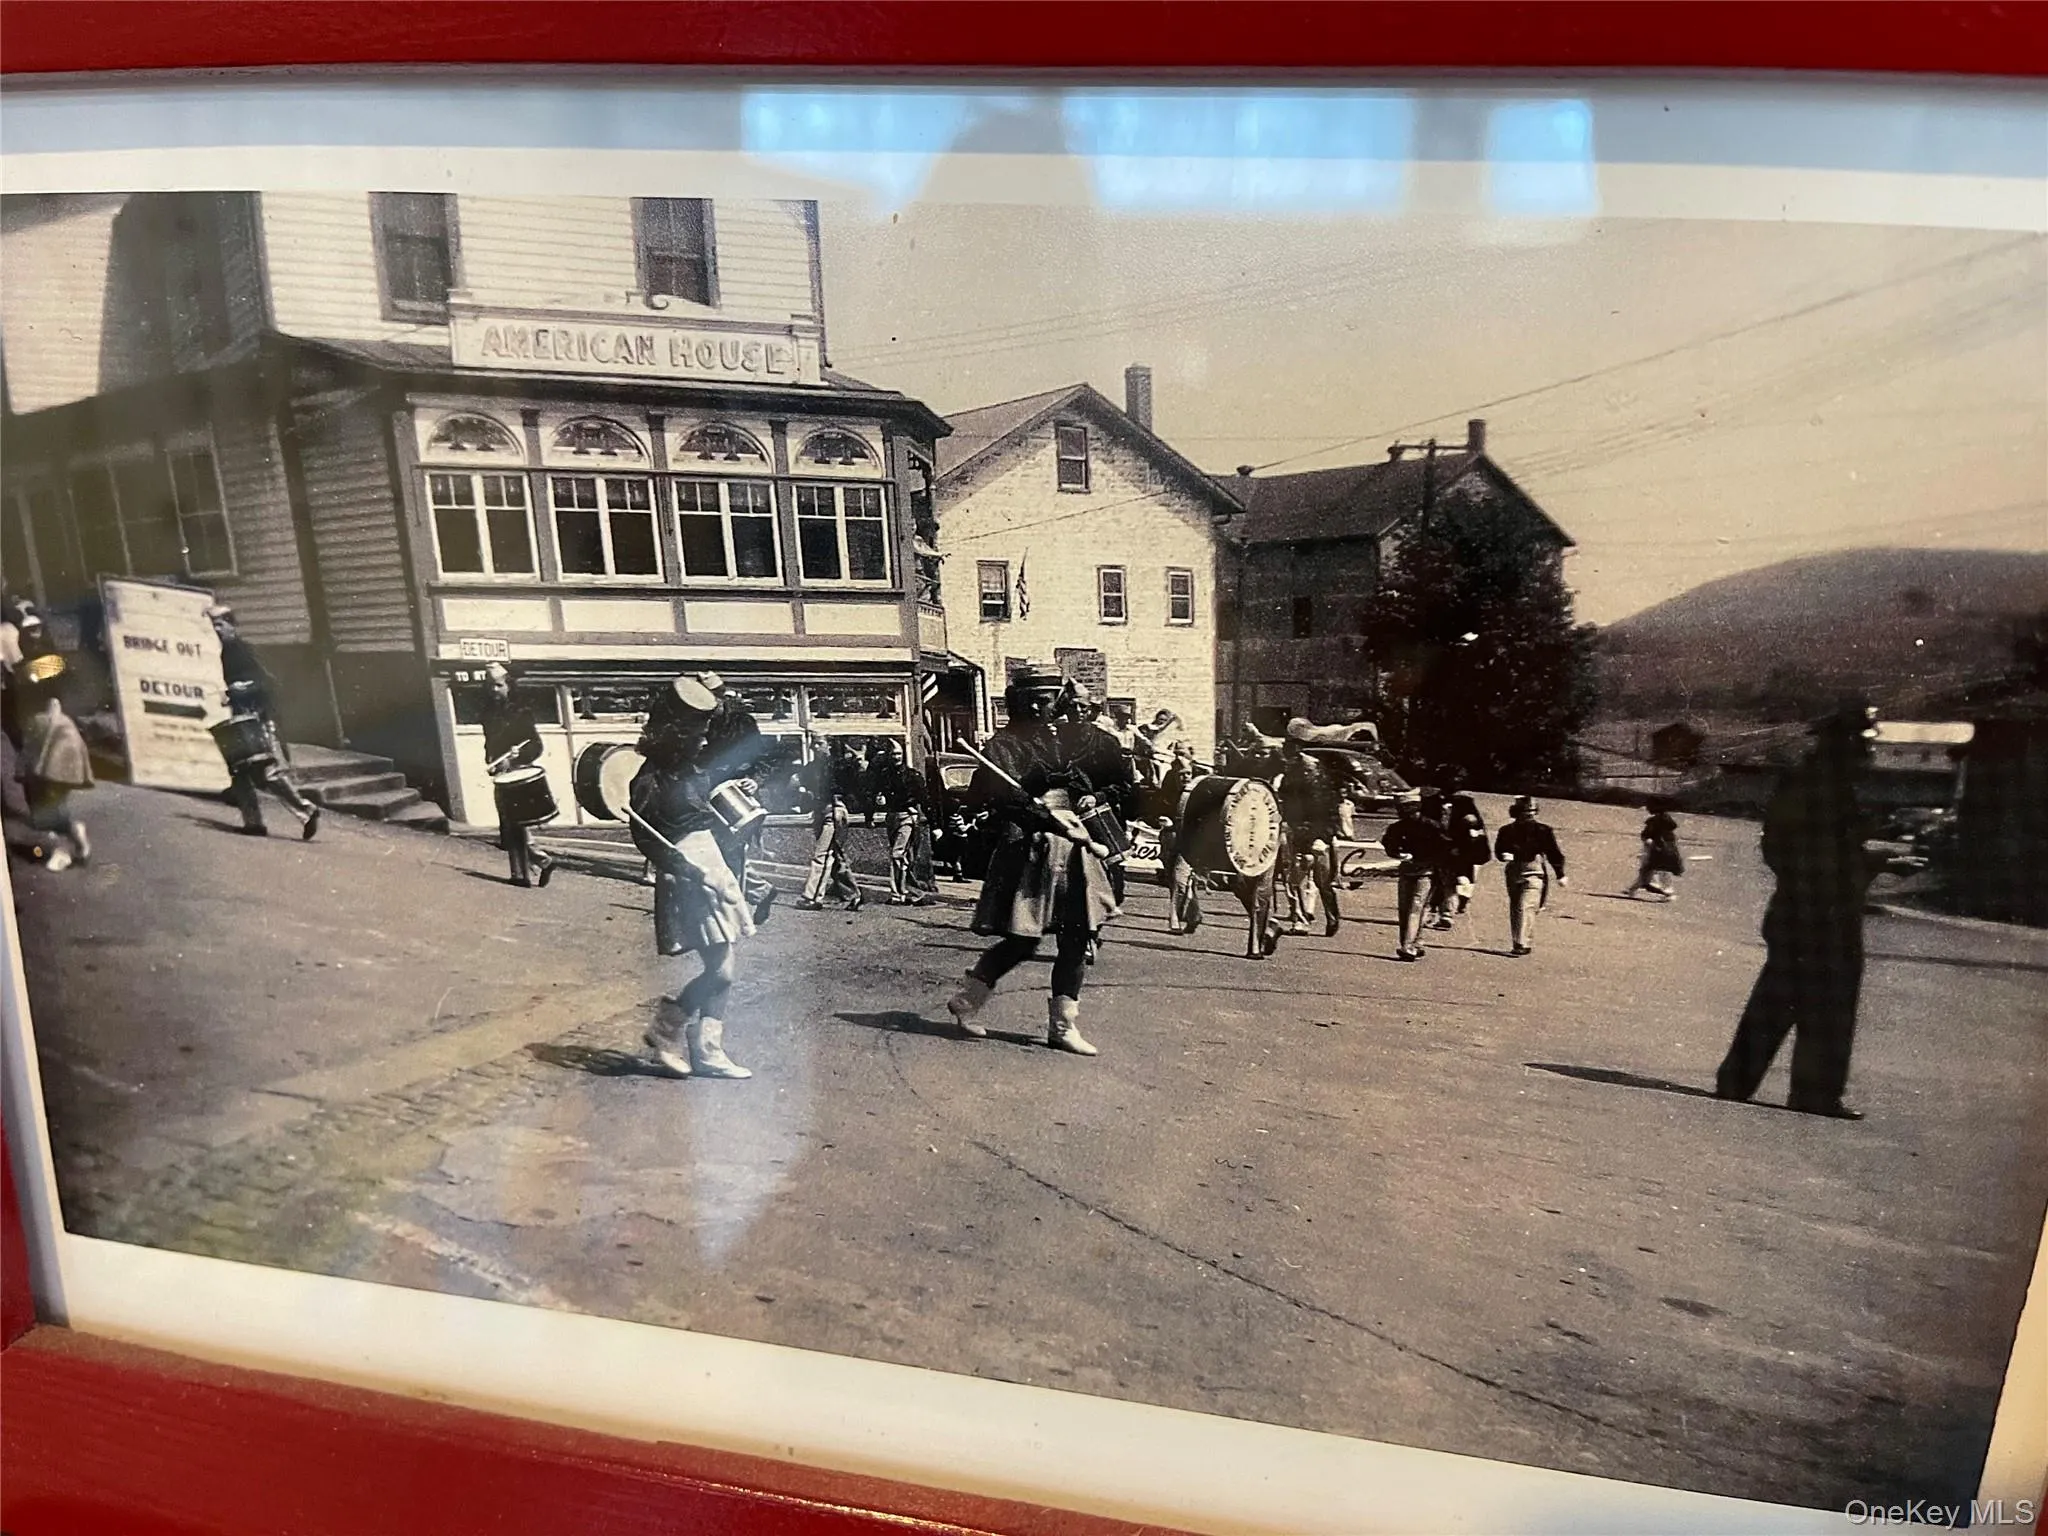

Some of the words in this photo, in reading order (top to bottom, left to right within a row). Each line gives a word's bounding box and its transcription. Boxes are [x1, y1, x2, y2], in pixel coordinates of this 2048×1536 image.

[481, 325, 657, 366] AMERICAN
[668, 337, 791, 375] HOUSE
[123, 635, 169, 654] BRIDGE
[176, 641, 201, 657] OUT
[140, 679, 205, 700] DETOUR
